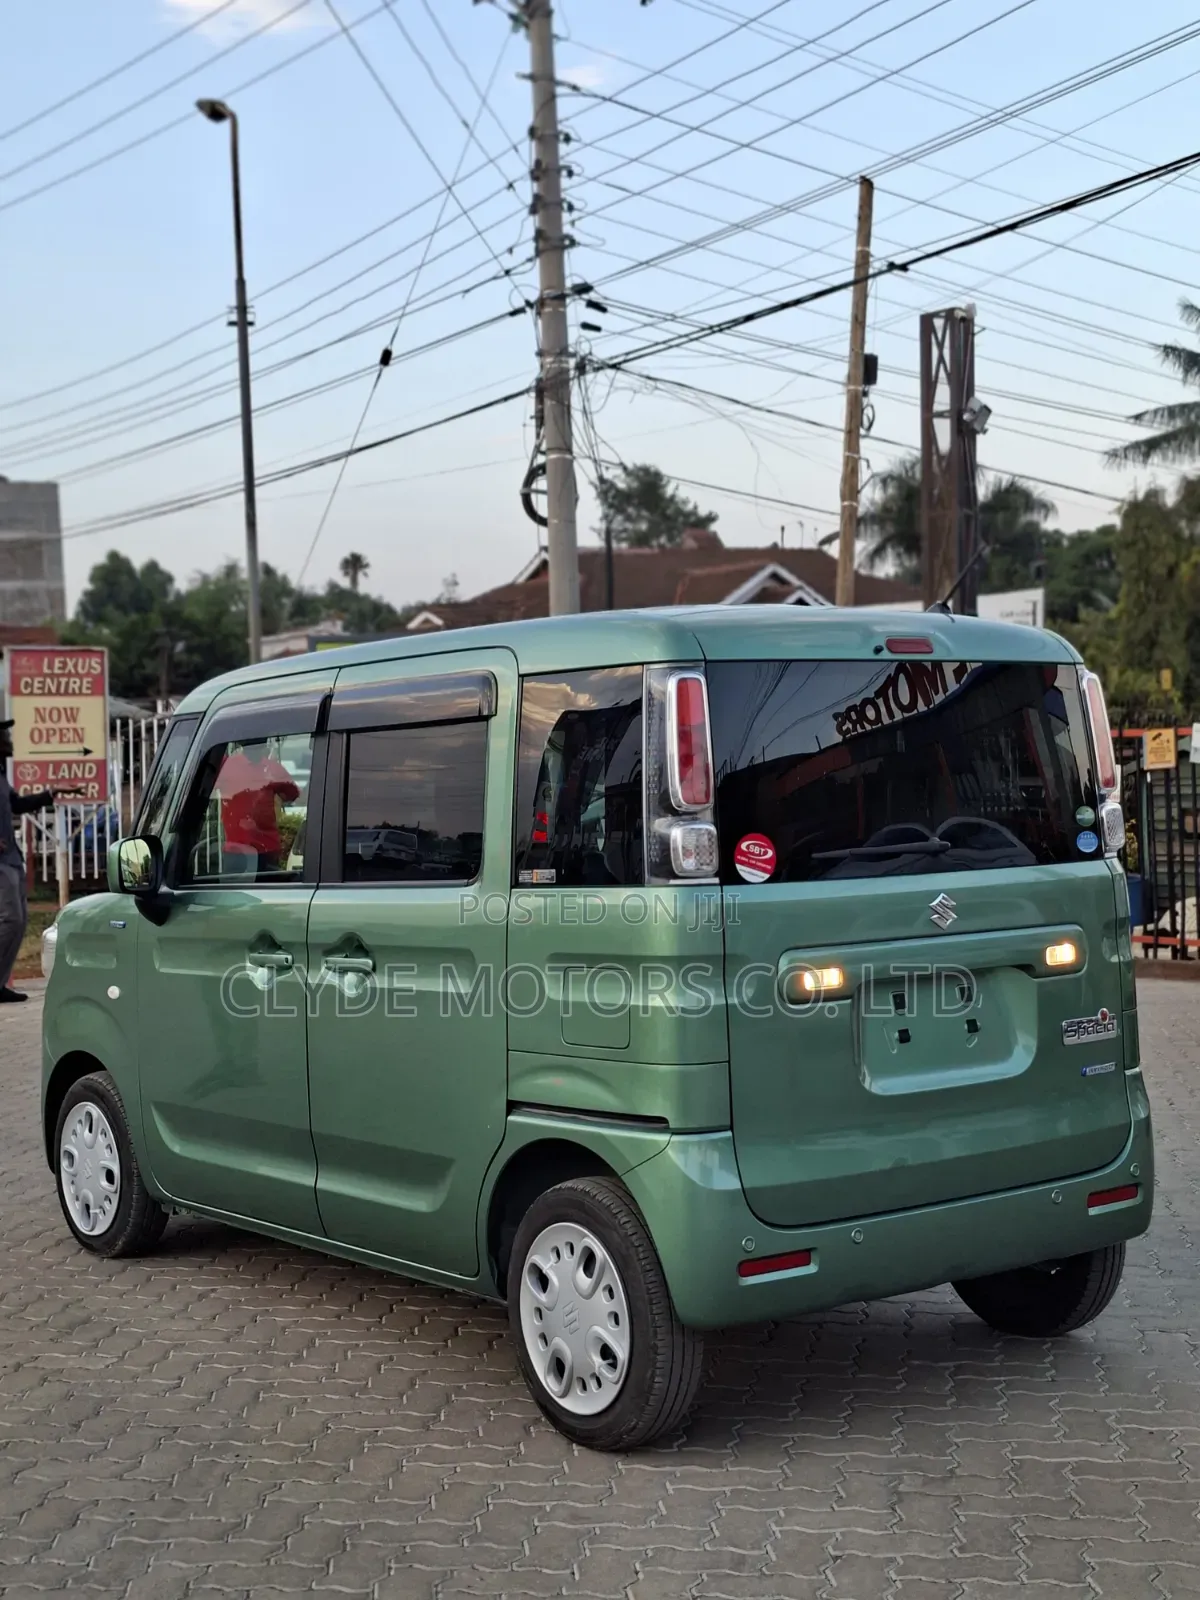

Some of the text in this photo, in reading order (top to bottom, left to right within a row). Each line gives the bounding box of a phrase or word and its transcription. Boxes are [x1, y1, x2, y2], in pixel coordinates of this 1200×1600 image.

[43, 657, 102, 674] LEXUS
[20, 677, 93, 694] CENTRE
[34, 706, 81, 724] NOW
[29, 727, 85, 745] OPEN
[47, 762, 97, 780] LAND
[749, 844, 765, 856] SBT
[1064, 1021, 1115, 1040] Spacia
